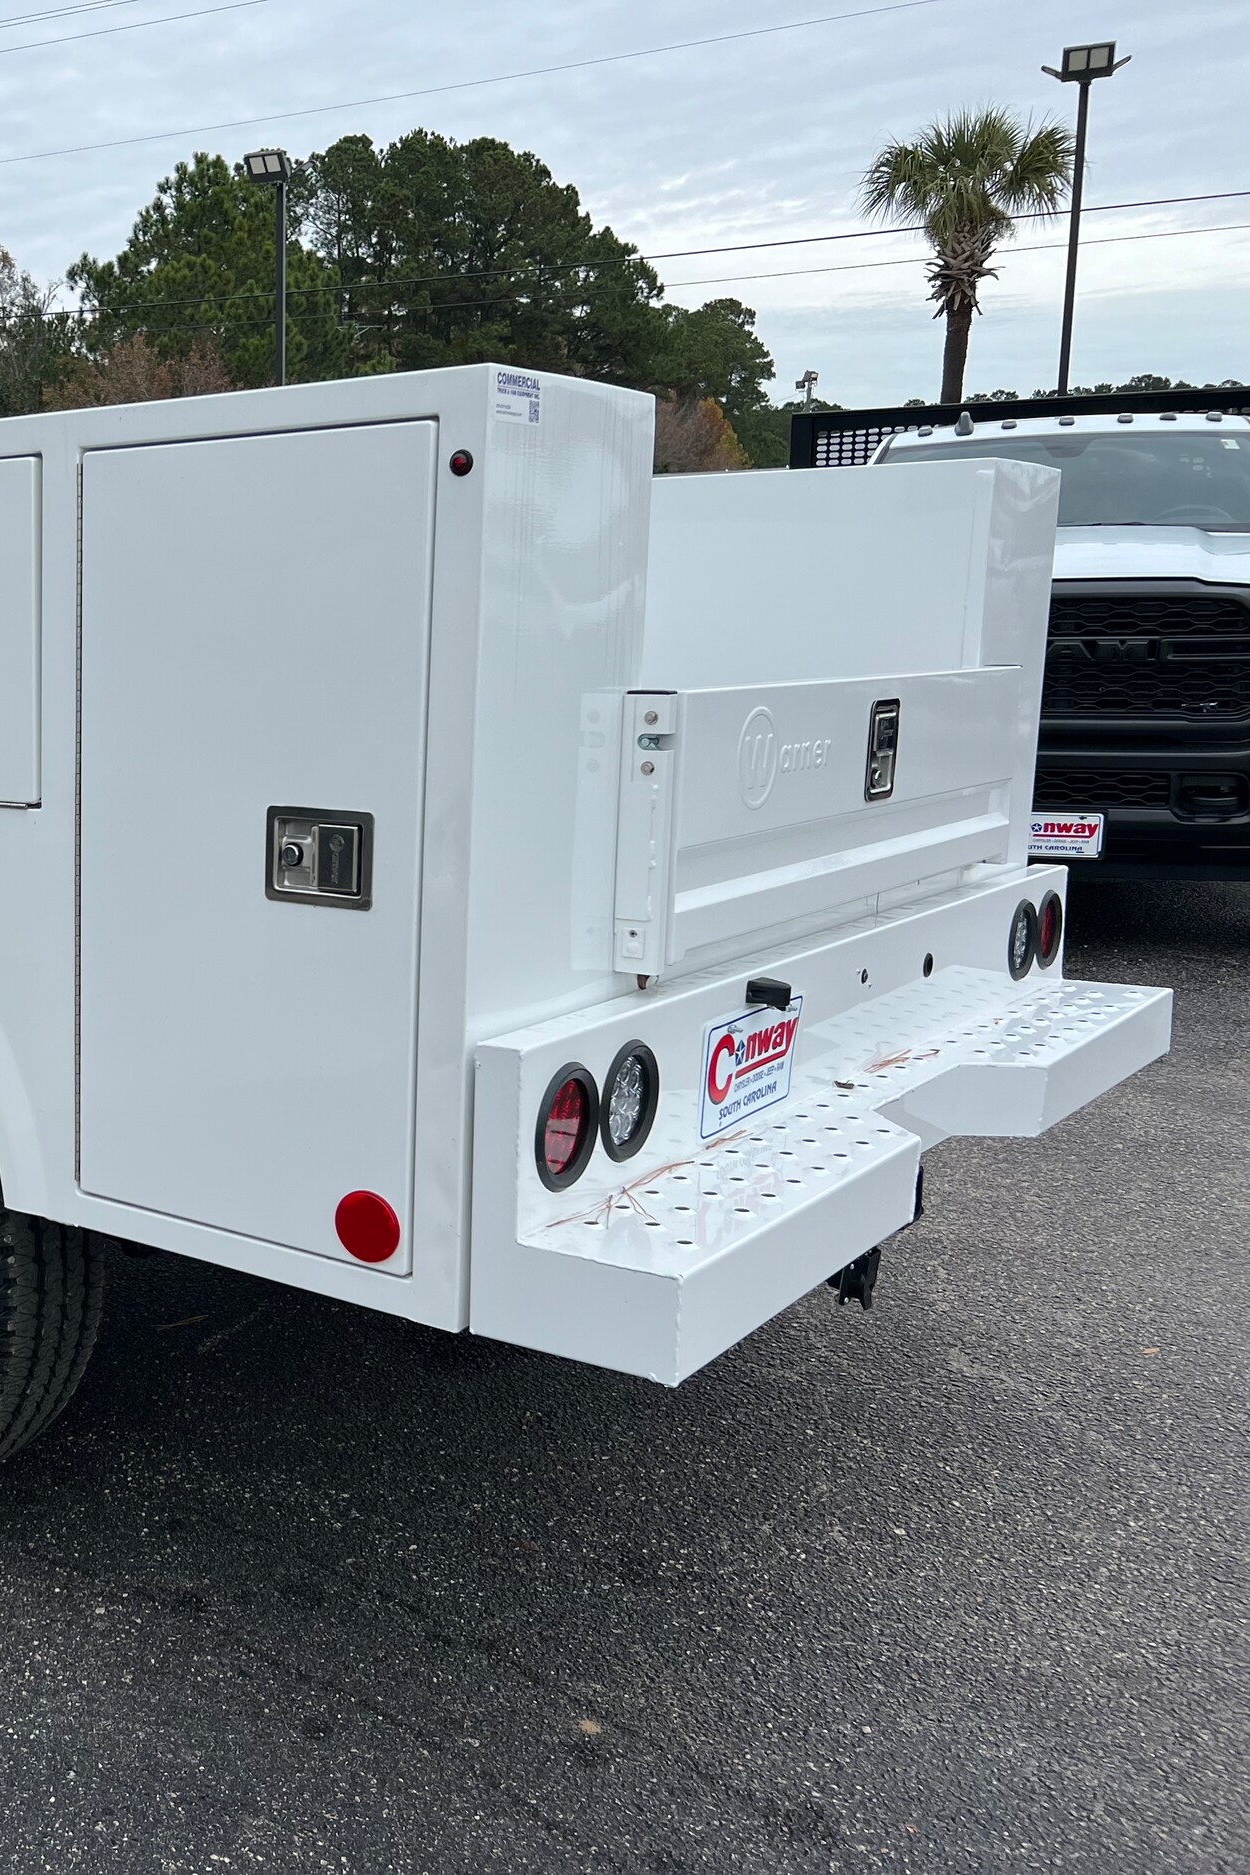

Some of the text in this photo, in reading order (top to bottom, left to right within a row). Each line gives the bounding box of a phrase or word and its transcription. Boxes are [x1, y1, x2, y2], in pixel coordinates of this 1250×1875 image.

[497, 372, 540, 391] COMMERCIAL
[718, 1081, 778, 1120] SOUTH CAROLINA
